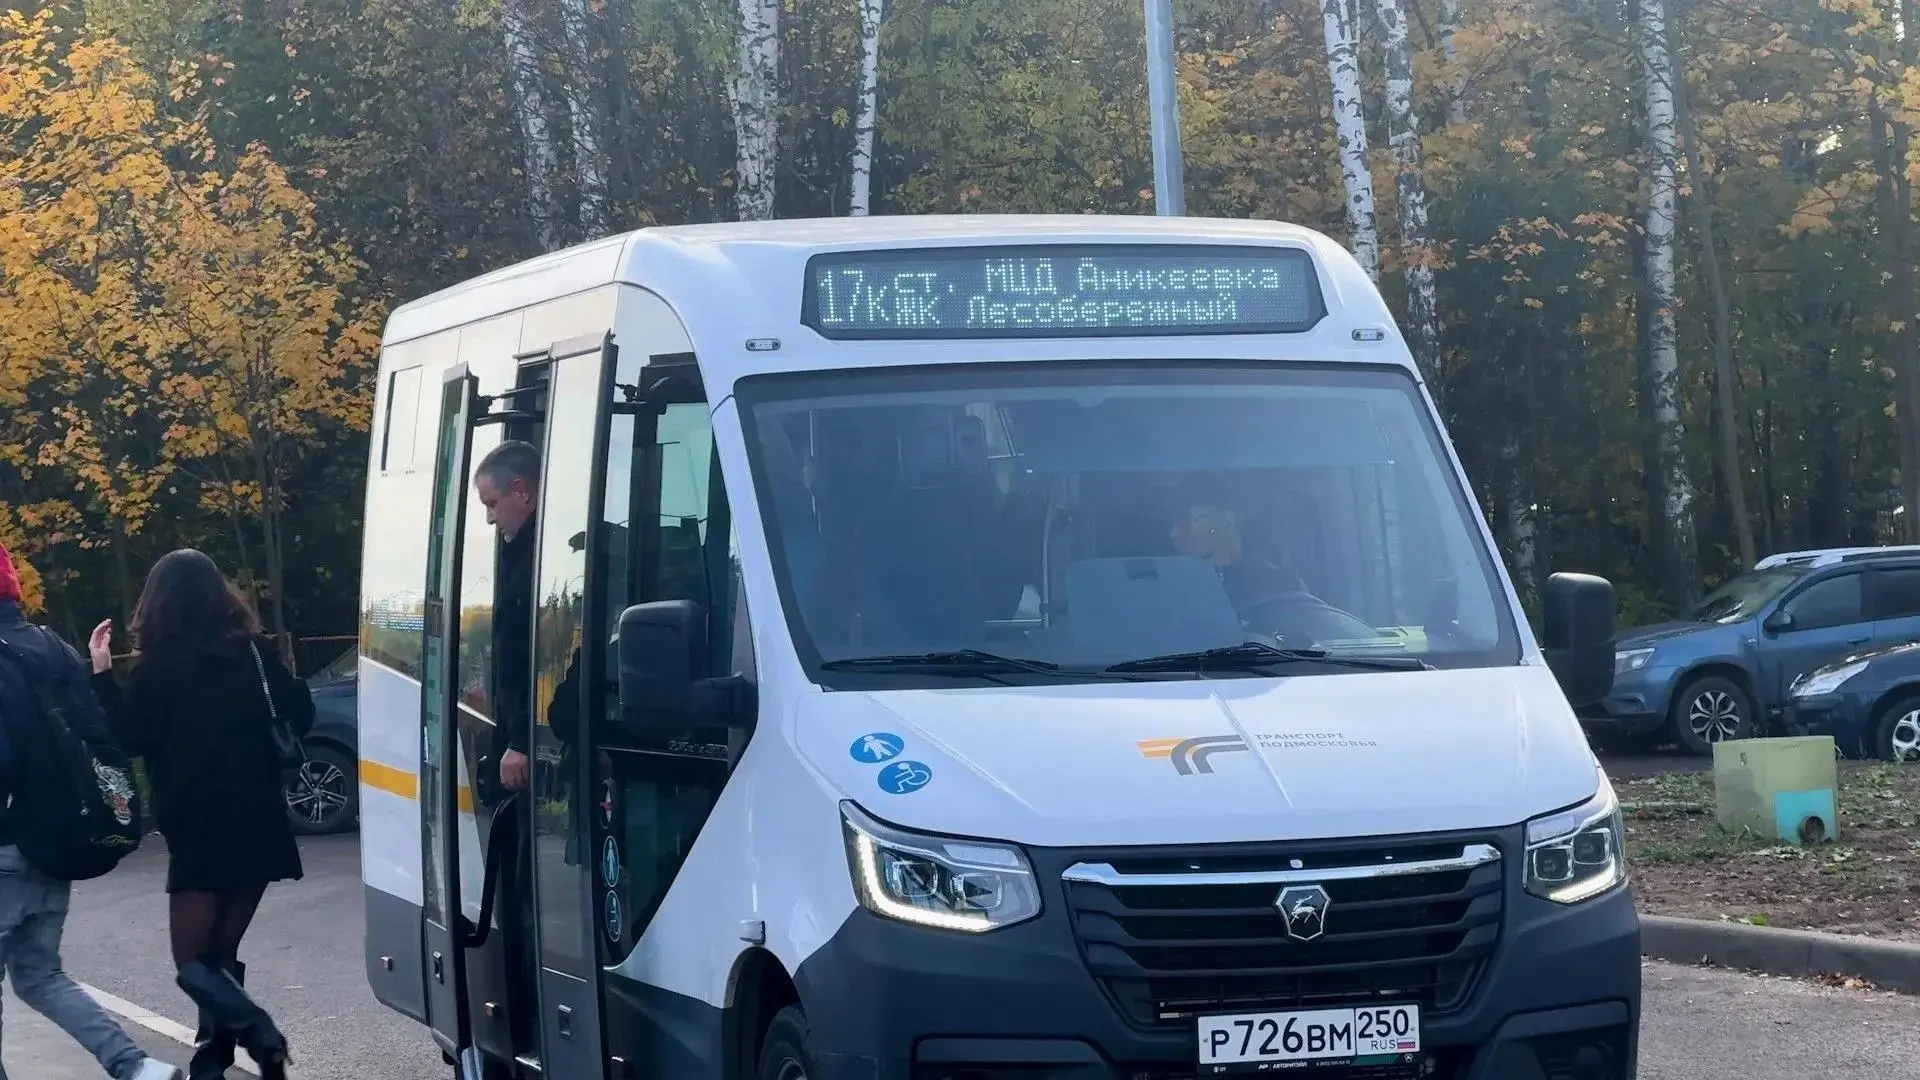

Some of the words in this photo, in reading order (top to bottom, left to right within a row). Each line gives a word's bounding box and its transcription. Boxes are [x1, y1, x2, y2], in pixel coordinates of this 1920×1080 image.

[985, 259, 1058, 295] МЦД
[1078, 259, 1280, 290] Аникеевка
[895, 296, 940, 325] ЖК
[966, 292, 1237, 326] Лесобережный
[1260, 740, 1378, 748] ПОДМОСКОВЬЯ
[1358, 1009, 1409, 1039] 250
[1371, 1040, 1396, 1050] RUS
